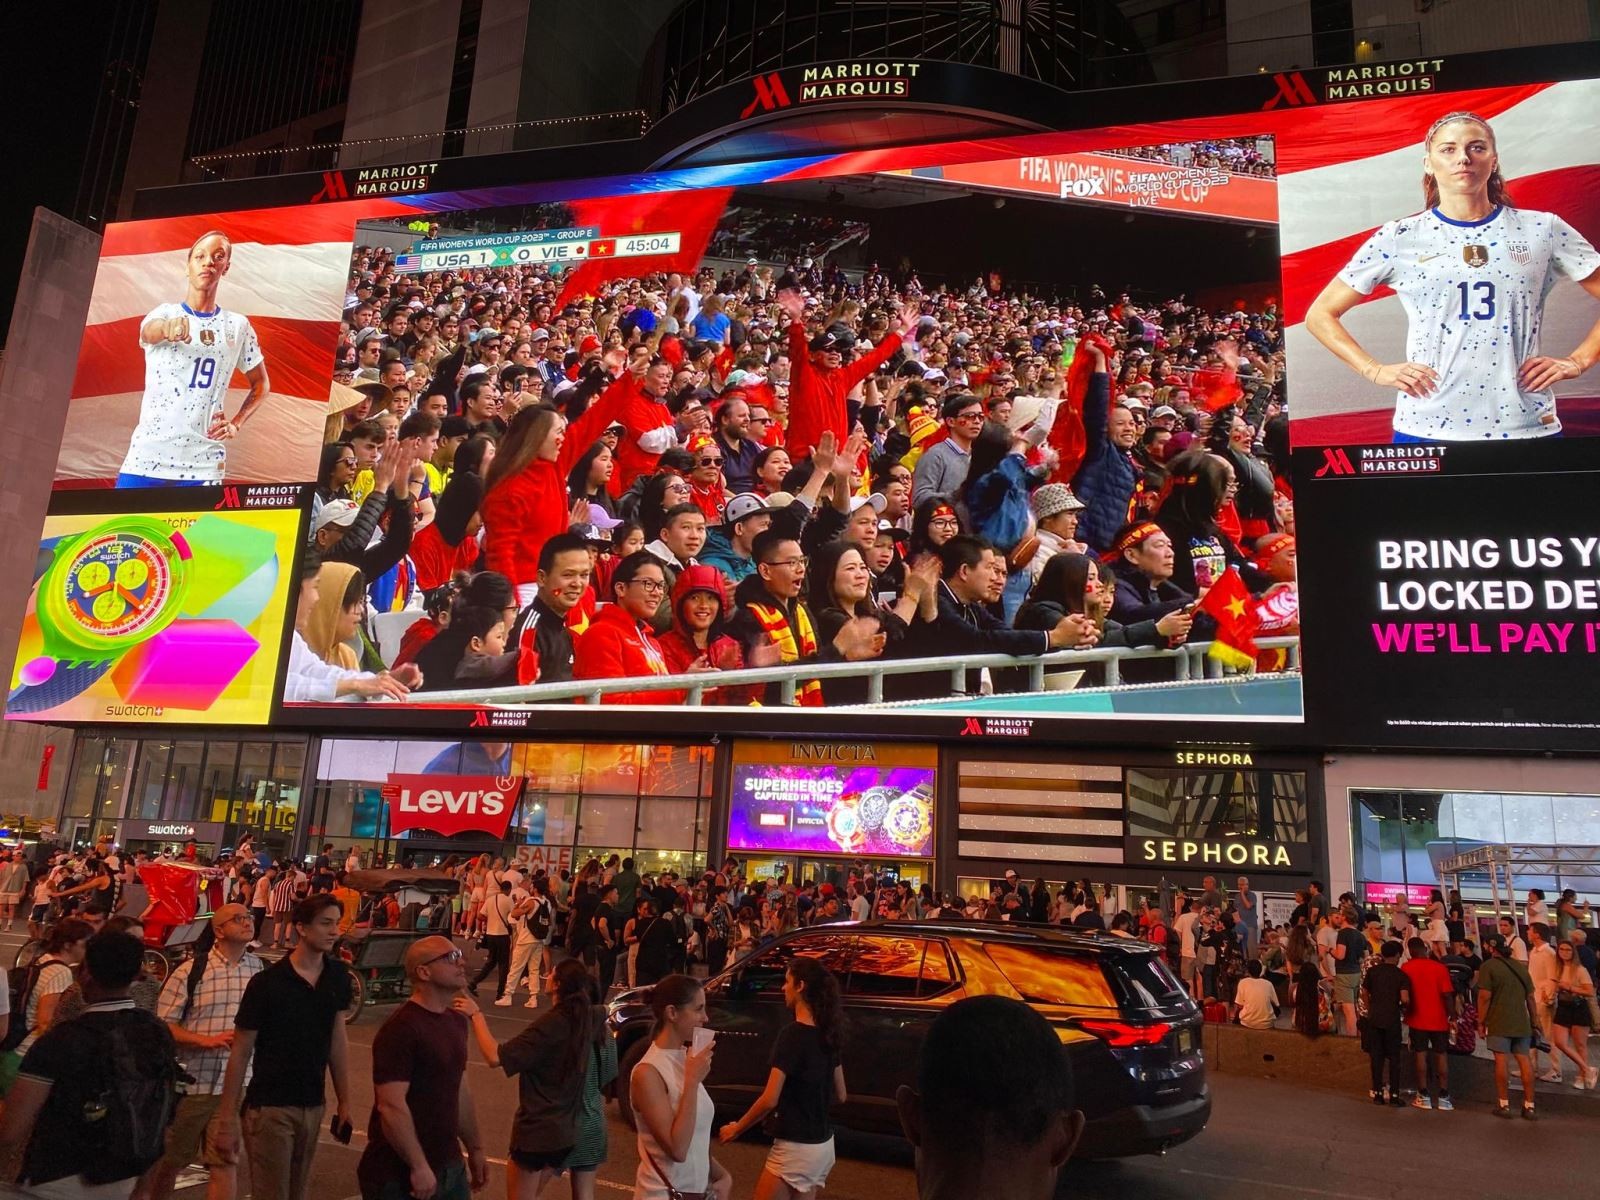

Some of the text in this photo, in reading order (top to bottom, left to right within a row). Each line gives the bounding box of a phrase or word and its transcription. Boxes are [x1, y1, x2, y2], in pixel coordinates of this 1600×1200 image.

[804, 63, 920, 82] MARRIOTT
[1328, 60, 1444, 82] MARRIOTT
[803, 81, 905, 100] MARQUIS
[1329, 78, 1431, 99] MARQUIS
[358, 164, 438, 181] MARRIOTT
[1020, 157, 1051, 183] FIFA
[1156, 166, 1219, 181] WOMEN'S
[356, 179, 426, 195] MARQUIS
[1060, 178, 1104, 199] FOX
[1165, 179, 1193, 192] CUP
[1193, 176, 1229, 188] 2023
[1130, 195, 1158, 207] LIVE
[420, 242, 437, 251] FIFA
[438, 239, 474, 250] WOMEN'S
[475, 237, 503, 248] WORLD
[503, 235, 520, 246] CUP
[557, 230, 586, 240] GROUP
[587, 229, 592, 238] E
[626, 238, 670, 252] 45:04
[437, 254, 470, 267] USA
[480, 252, 486, 264] 1
[542, 247, 568, 259] VIE
[1457, 281, 1495, 320] 13
[188, 357, 216, 388] 19
[1362, 446, 1446, 459] MARRIOTT
[1363, 460, 1437, 472] MARQUIS
[247, 486, 302, 496] MARRIOTT
[246, 497, 294, 506] MARQUIS
[1379, 537, 1600, 569] BRING US Y
[1379, 579, 1600, 611] LOCKED DE
[1372, 623, 1600, 653] WE'LL PAY I
[987, 719, 1034, 727] MARRIOTT
[987, 727, 1028, 735] MARQUIS
[791, 743, 876, 761] INVICTA
[1176, 752, 1253, 765] SEPHORA
[744, 778, 844, 794] SUPERHEROES
[754, 791, 833, 803] CAPTURED IN TIME
[797, 817, 825, 825] INVICTA
[148, 824, 188, 836] swatch
[518, 846, 570, 865] SALE
[1144, 840, 1292, 867] SEPHORA
